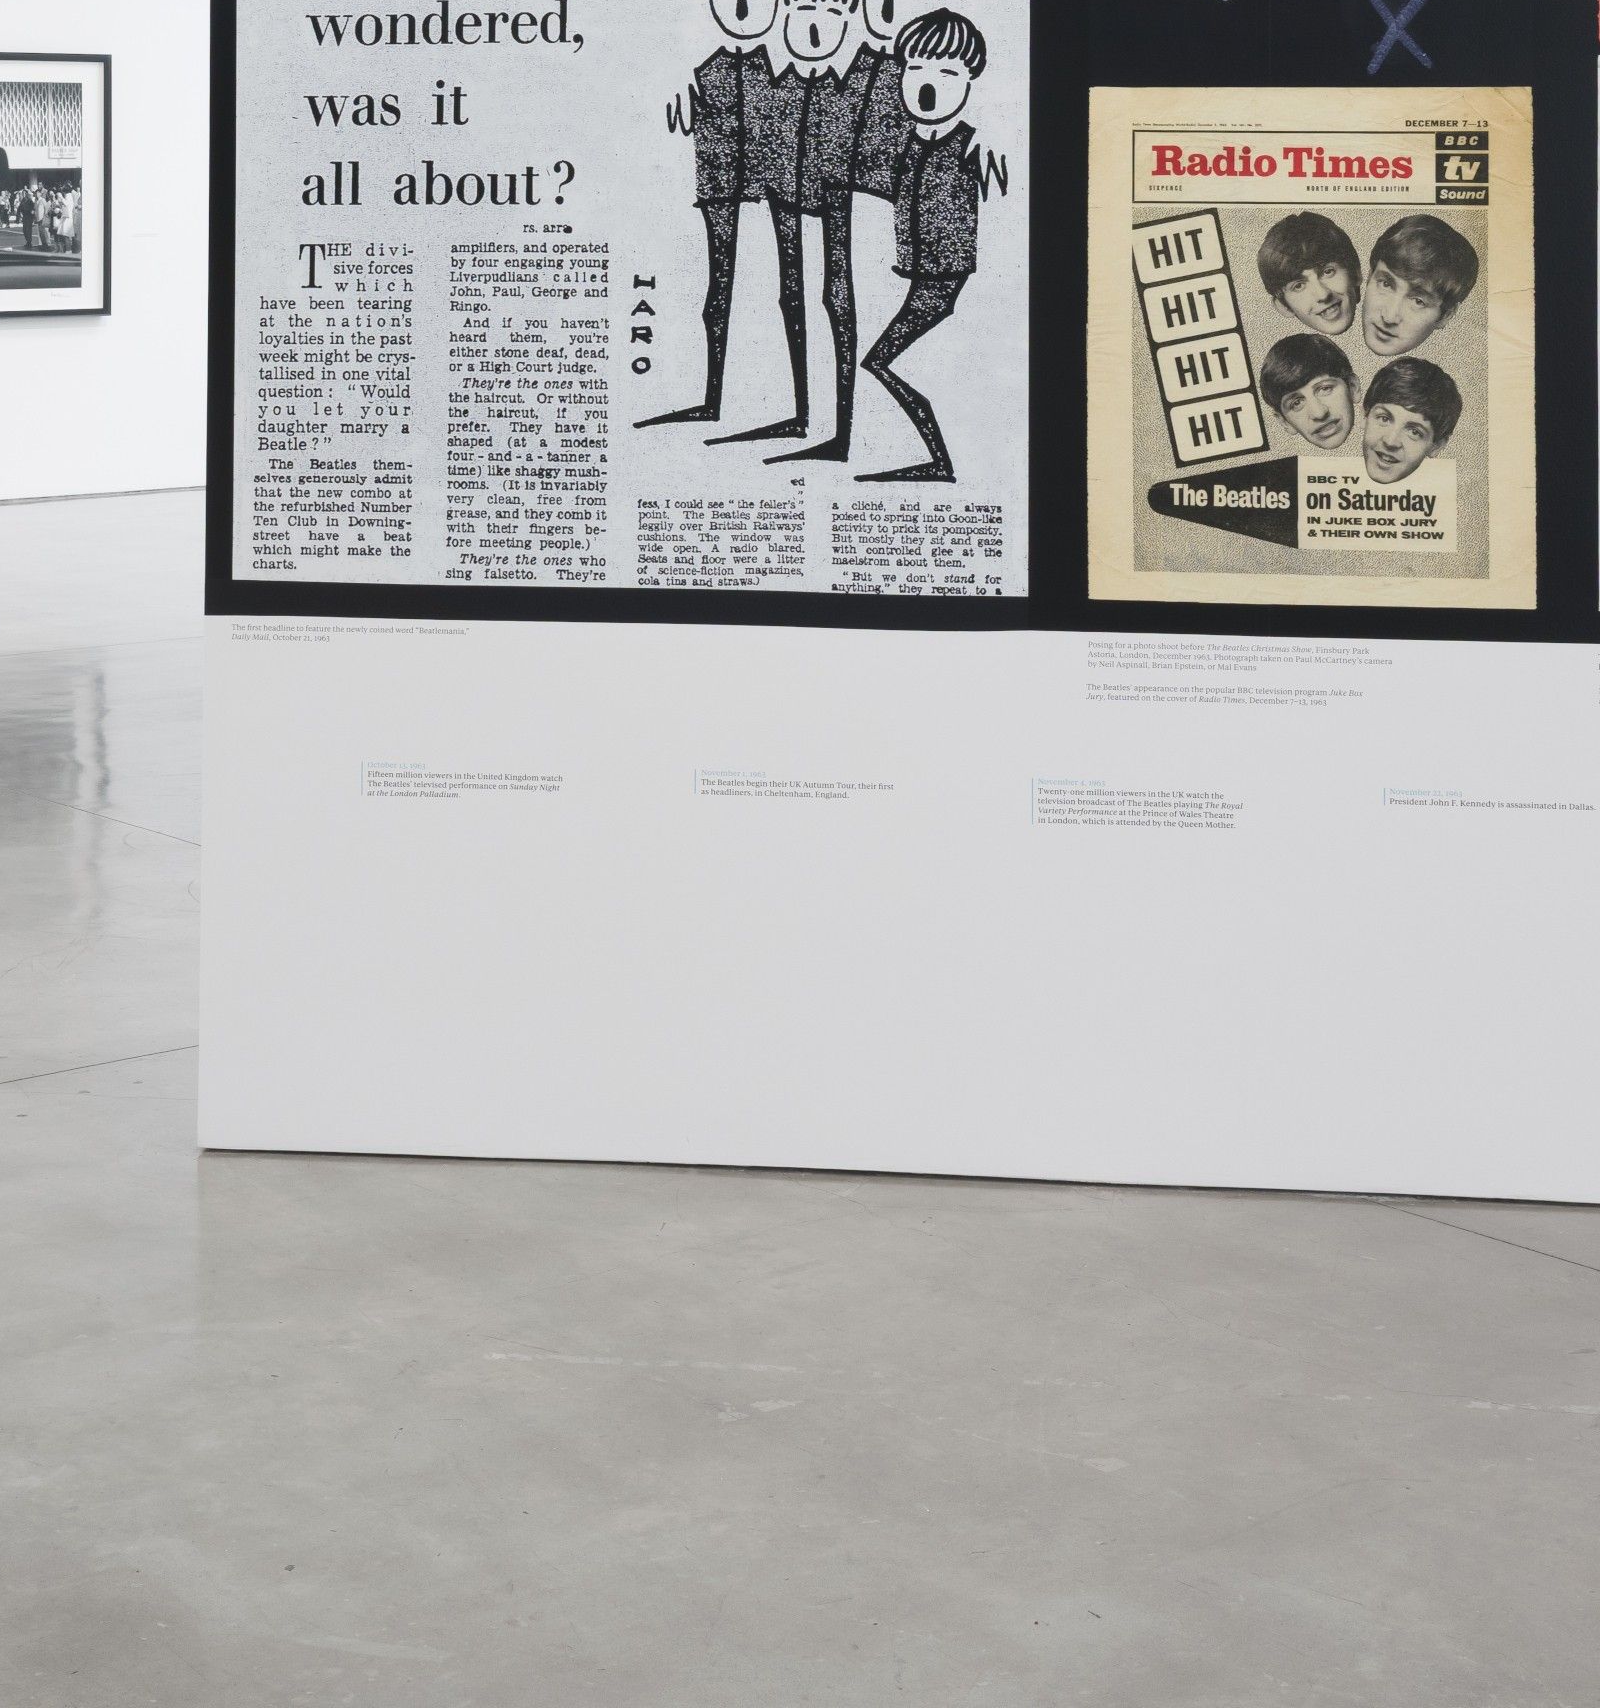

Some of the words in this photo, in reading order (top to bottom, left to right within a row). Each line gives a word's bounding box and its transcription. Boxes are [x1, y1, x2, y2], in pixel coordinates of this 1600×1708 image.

[306, 87, 401, 126] was
[432, 81, 468, 126] it
[1444, 136, 1479, 146] BBC
[1151, 145, 1277, 176] Radio
[1283, 147, 1413, 179] Times
[1443, 157, 1480, 180] tv
[302, 161, 360, 205] all
[394, 160, 576, 205] about?
[1439, 189, 1485, 200] Sound
[1149, 227, 1206, 270] HIT
[1161, 287, 1218, 329] HIT
[259, 331, 324, 348] loyalties
[330, 332, 344, 344] in
[351, 332, 375, 345] the
[380, 333, 412, 348] past
[450, 332, 486, 342] heard
[510, 332, 547, 344] them,
[569, 333, 609, 345] you're
[259, 350, 298, 362] week
[304, 350, 350, 365] might
[356, 350, 372, 362] be
[378, 352, 415, 365] crys-
[1174, 346, 1231, 388] HIT
[258, 420, 328, 435] daughter
[340, 423, 388, 436] marry
[401, 424, 409, 434] a
[1188, 406, 1244, 447] HIT
[1307, 475, 1337, 484] BBC
[1342, 475, 1360, 485] TV
[1170, 484, 1208, 507] The
[1213, 487, 1290, 510] Beatles
[1306, 493, 1332, 510] on
[1337, 489, 1436, 516] Saturday
[1307, 517, 1321, 526] IN
[1325, 517, 1362, 526] JUKE
[1366, 517, 1397, 527] BOX
[1400, 517, 1437, 527] JURY
[1307, 529, 1317, 538] &
[1320, 529, 1360, 539] THEIR
[1364, 530, 1398, 539] OWN
[1401, 530, 1444, 540] SHOW
[638, 544, 663, 552] wide
[730, 544, 758, 553] radio
[768, 544, 805, 553] blared.
[505, 774, 539, 782] Kingdom
[1390, 798, 1427, 806] President
[1460, 800, 1495, 809] Kennedy
[1506, 801, 1556, 810] assassinated
[1569, 803, 1596, 811] Dallas.
